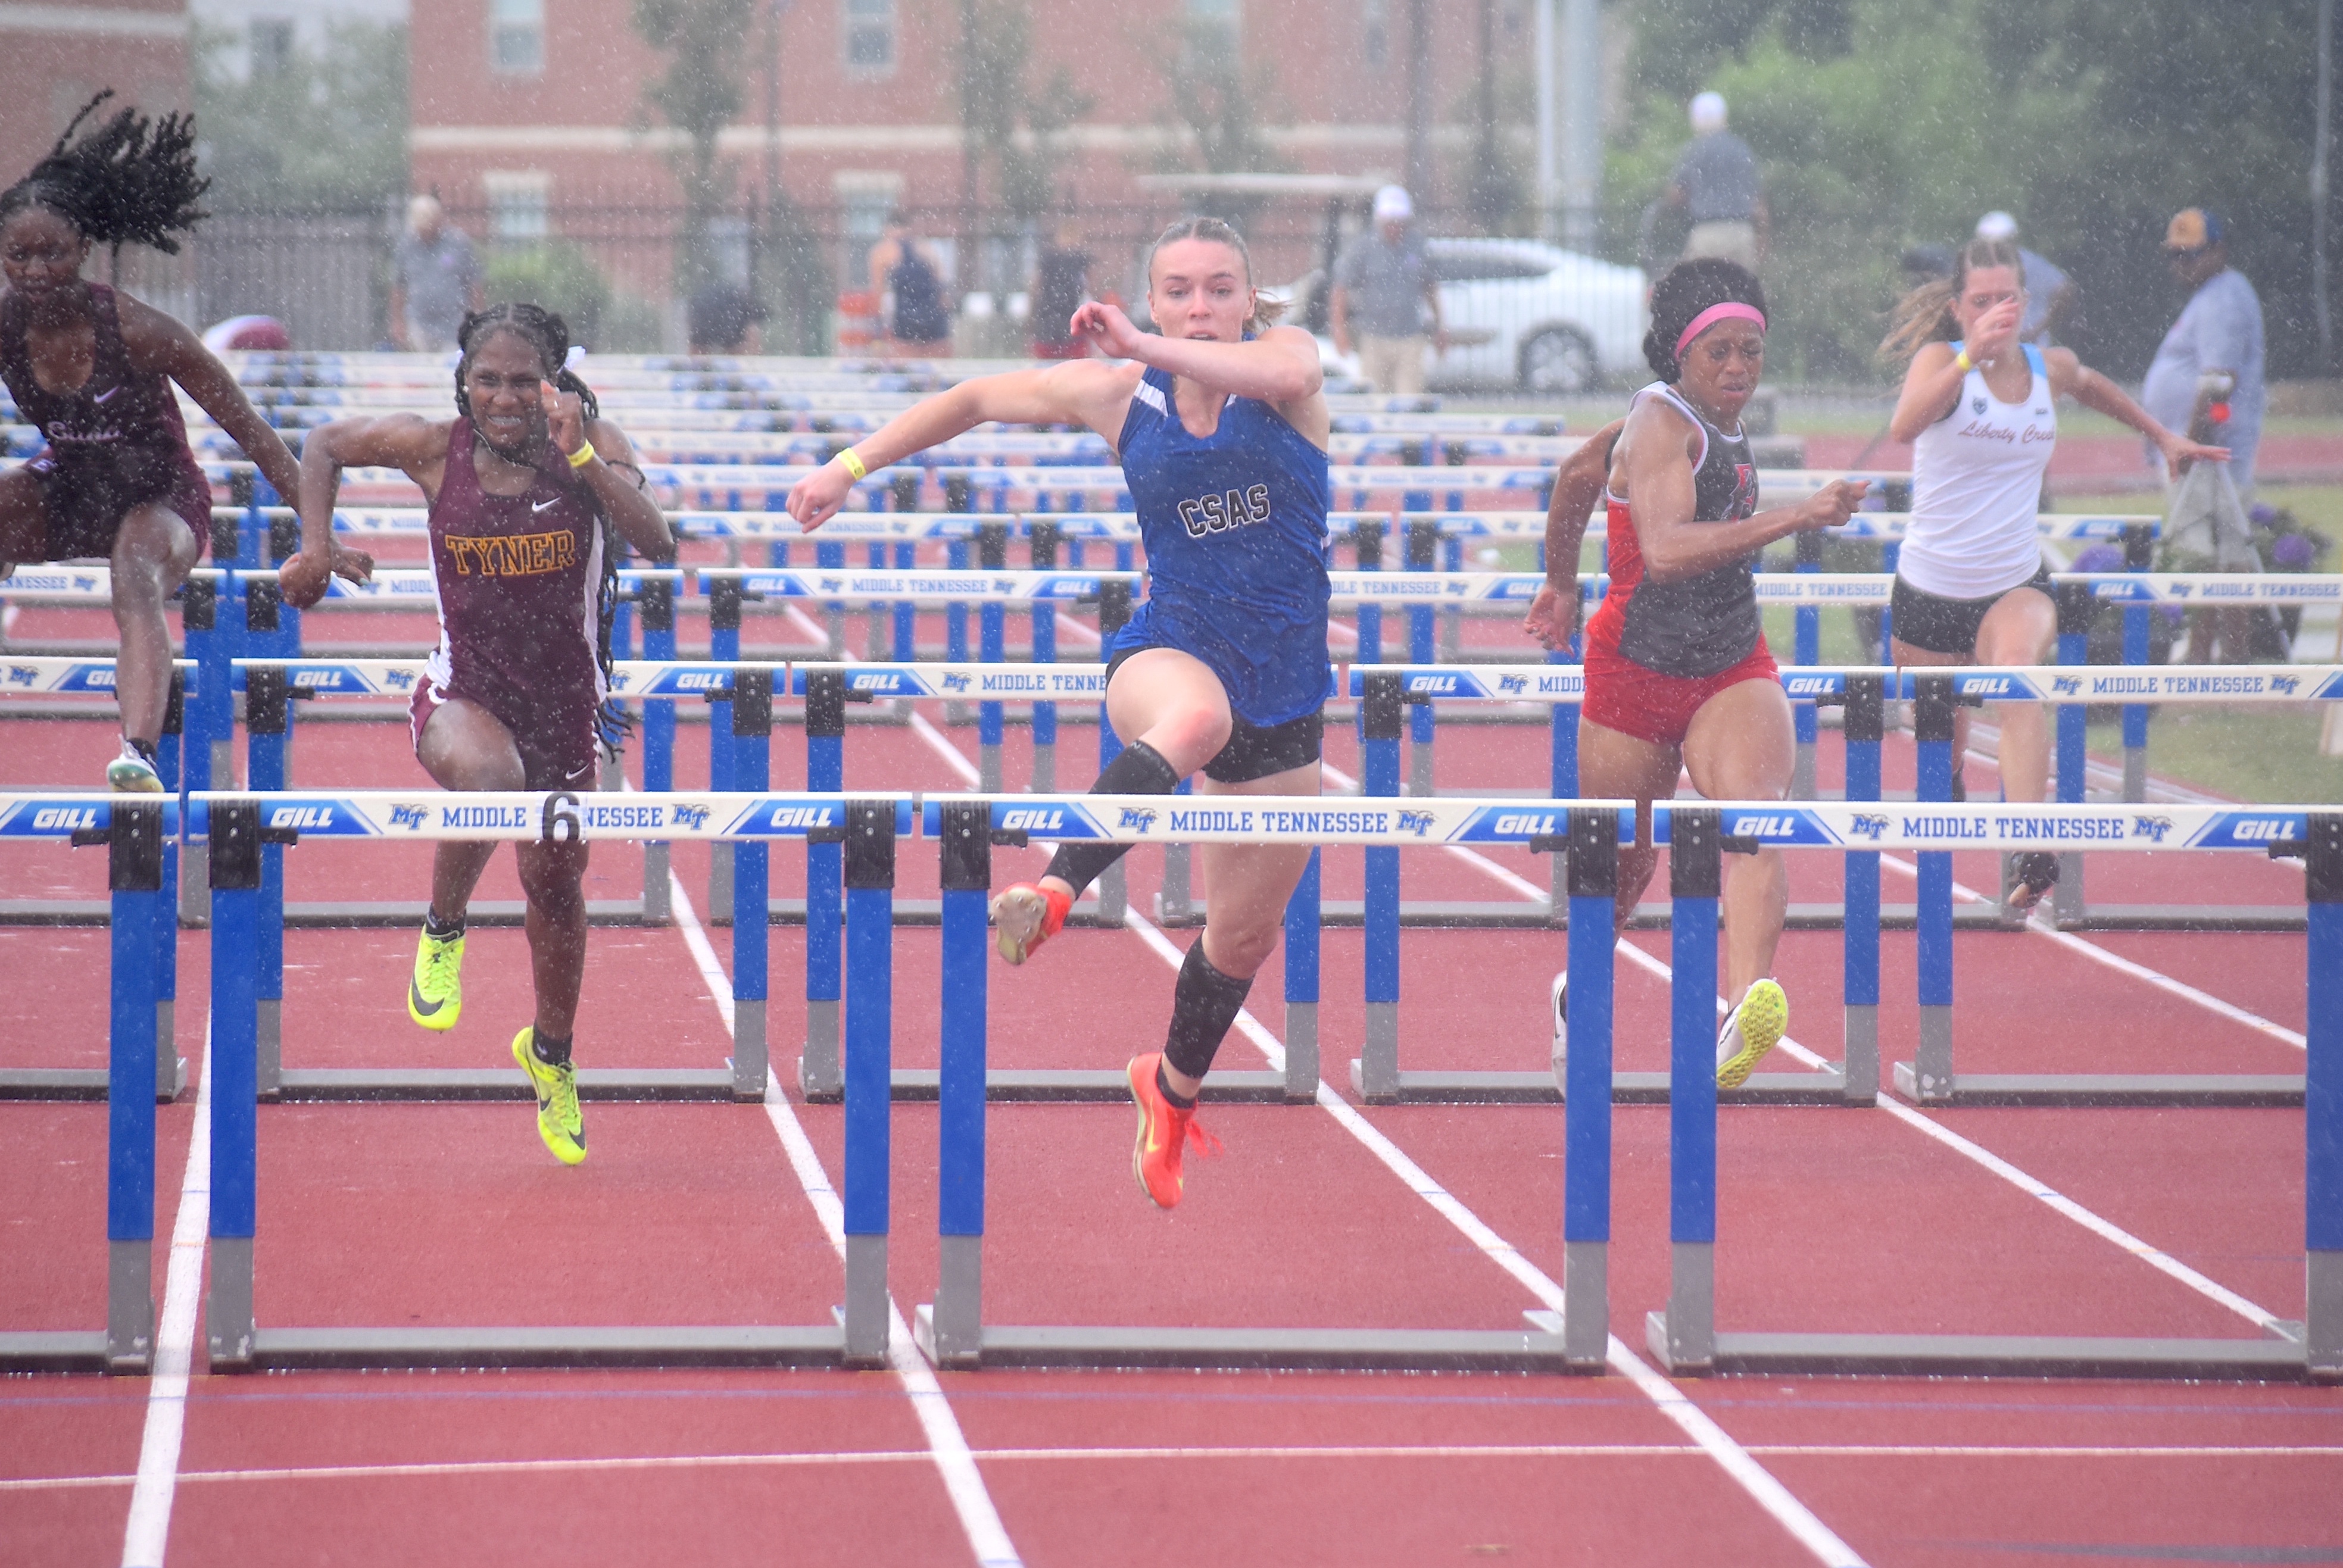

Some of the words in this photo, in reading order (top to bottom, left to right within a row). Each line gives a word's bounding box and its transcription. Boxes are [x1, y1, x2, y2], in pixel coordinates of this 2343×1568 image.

[1958, 420, 2017, 443] Liberty
[1177, 483, 1271, 538] CSAS
[445, 530, 575, 575] TYNER
[852, 579, 903, 592] MIDDLE
[910, 580, 987, 592] TENNESSEE
[1333, 581, 1357, 594] DLE
[1363, 582, 1440, 594] TENNESSEE
[1809, 583, 1887, 596] TENNESSEE
[294, 671, 342, 686] GILL
[676, 673, 725, 688] GILL
[853, 674, 901, 689] GILL
[982, 674, 1046, 691] MIDDLE
[1410, 676, 1457, 691] GILL
[1788, 677, 1836, 692] GILL
[1963, 677, 2011, 694] GILL
[2093, 676, 2158, 694] MIDDLE
[2164, 677, 2264, 694] TENNESSEE
[33, 808, 97, 829] GILL
[270, 807, 334, 828] GILL
[442, 807, 526, 827] MIDDLE
[588, 807, 663, 827] NESSEE
[542, 791, 581, 841] 6
[770, 807, 832, 828] GILL
[1002, 809, 1063, 829] GILL
[1171, 810, 1253, 832] MIDDLE
[1262, 811, 1389, 833] TENNESSEE
[1494, 814, 1555, 834] GILL
[1732, 816, 1795, 836] GILL
[1903, 817, 1987, 838] MIDDLE
[1995, 817, 2124, 839] TENNESSEE
[2232, 819, 2295, 841] GILL
